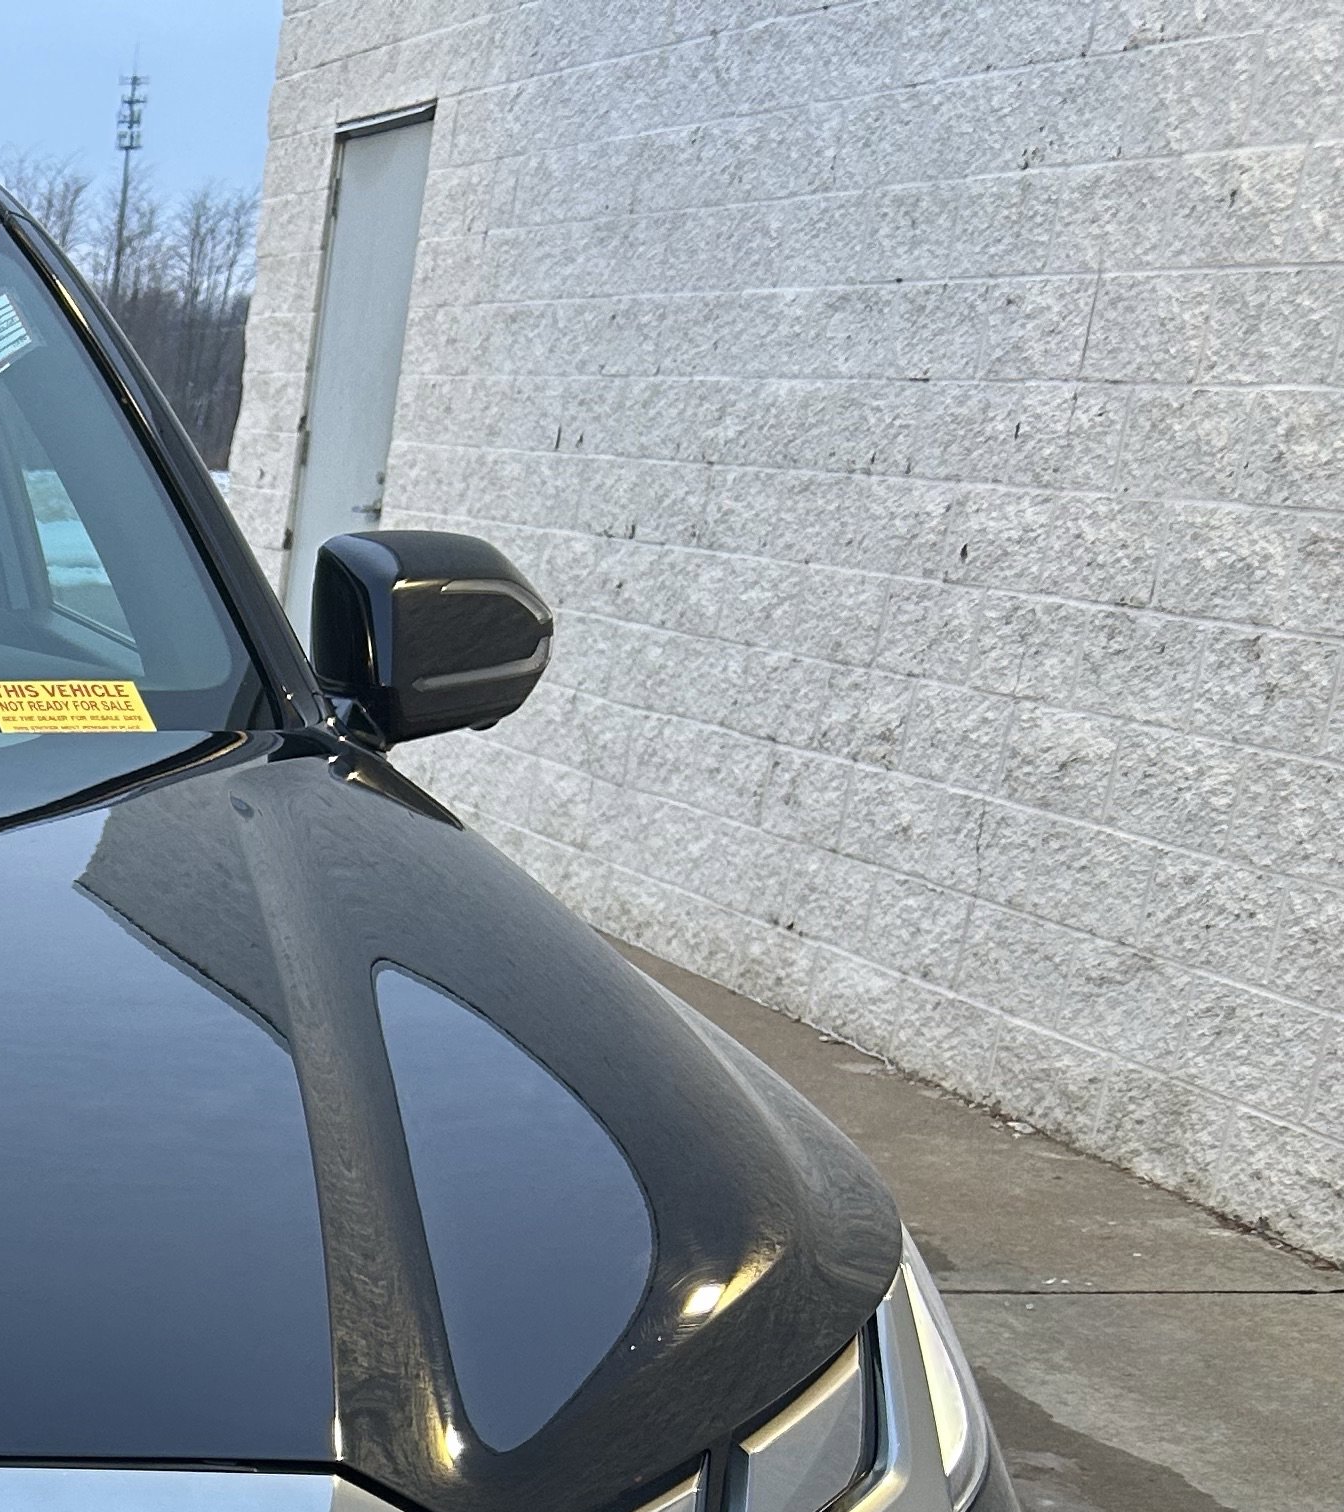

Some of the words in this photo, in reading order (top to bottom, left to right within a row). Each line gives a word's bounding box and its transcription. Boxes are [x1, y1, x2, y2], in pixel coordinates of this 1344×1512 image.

[40, 684, 130, 698] VEHICLE
[0, 700, 25, 712] NOT
[29, 700, 70, 712] READY
[74, 700, 100, 712] FOR
[102, 700, 135, 712] SALE
